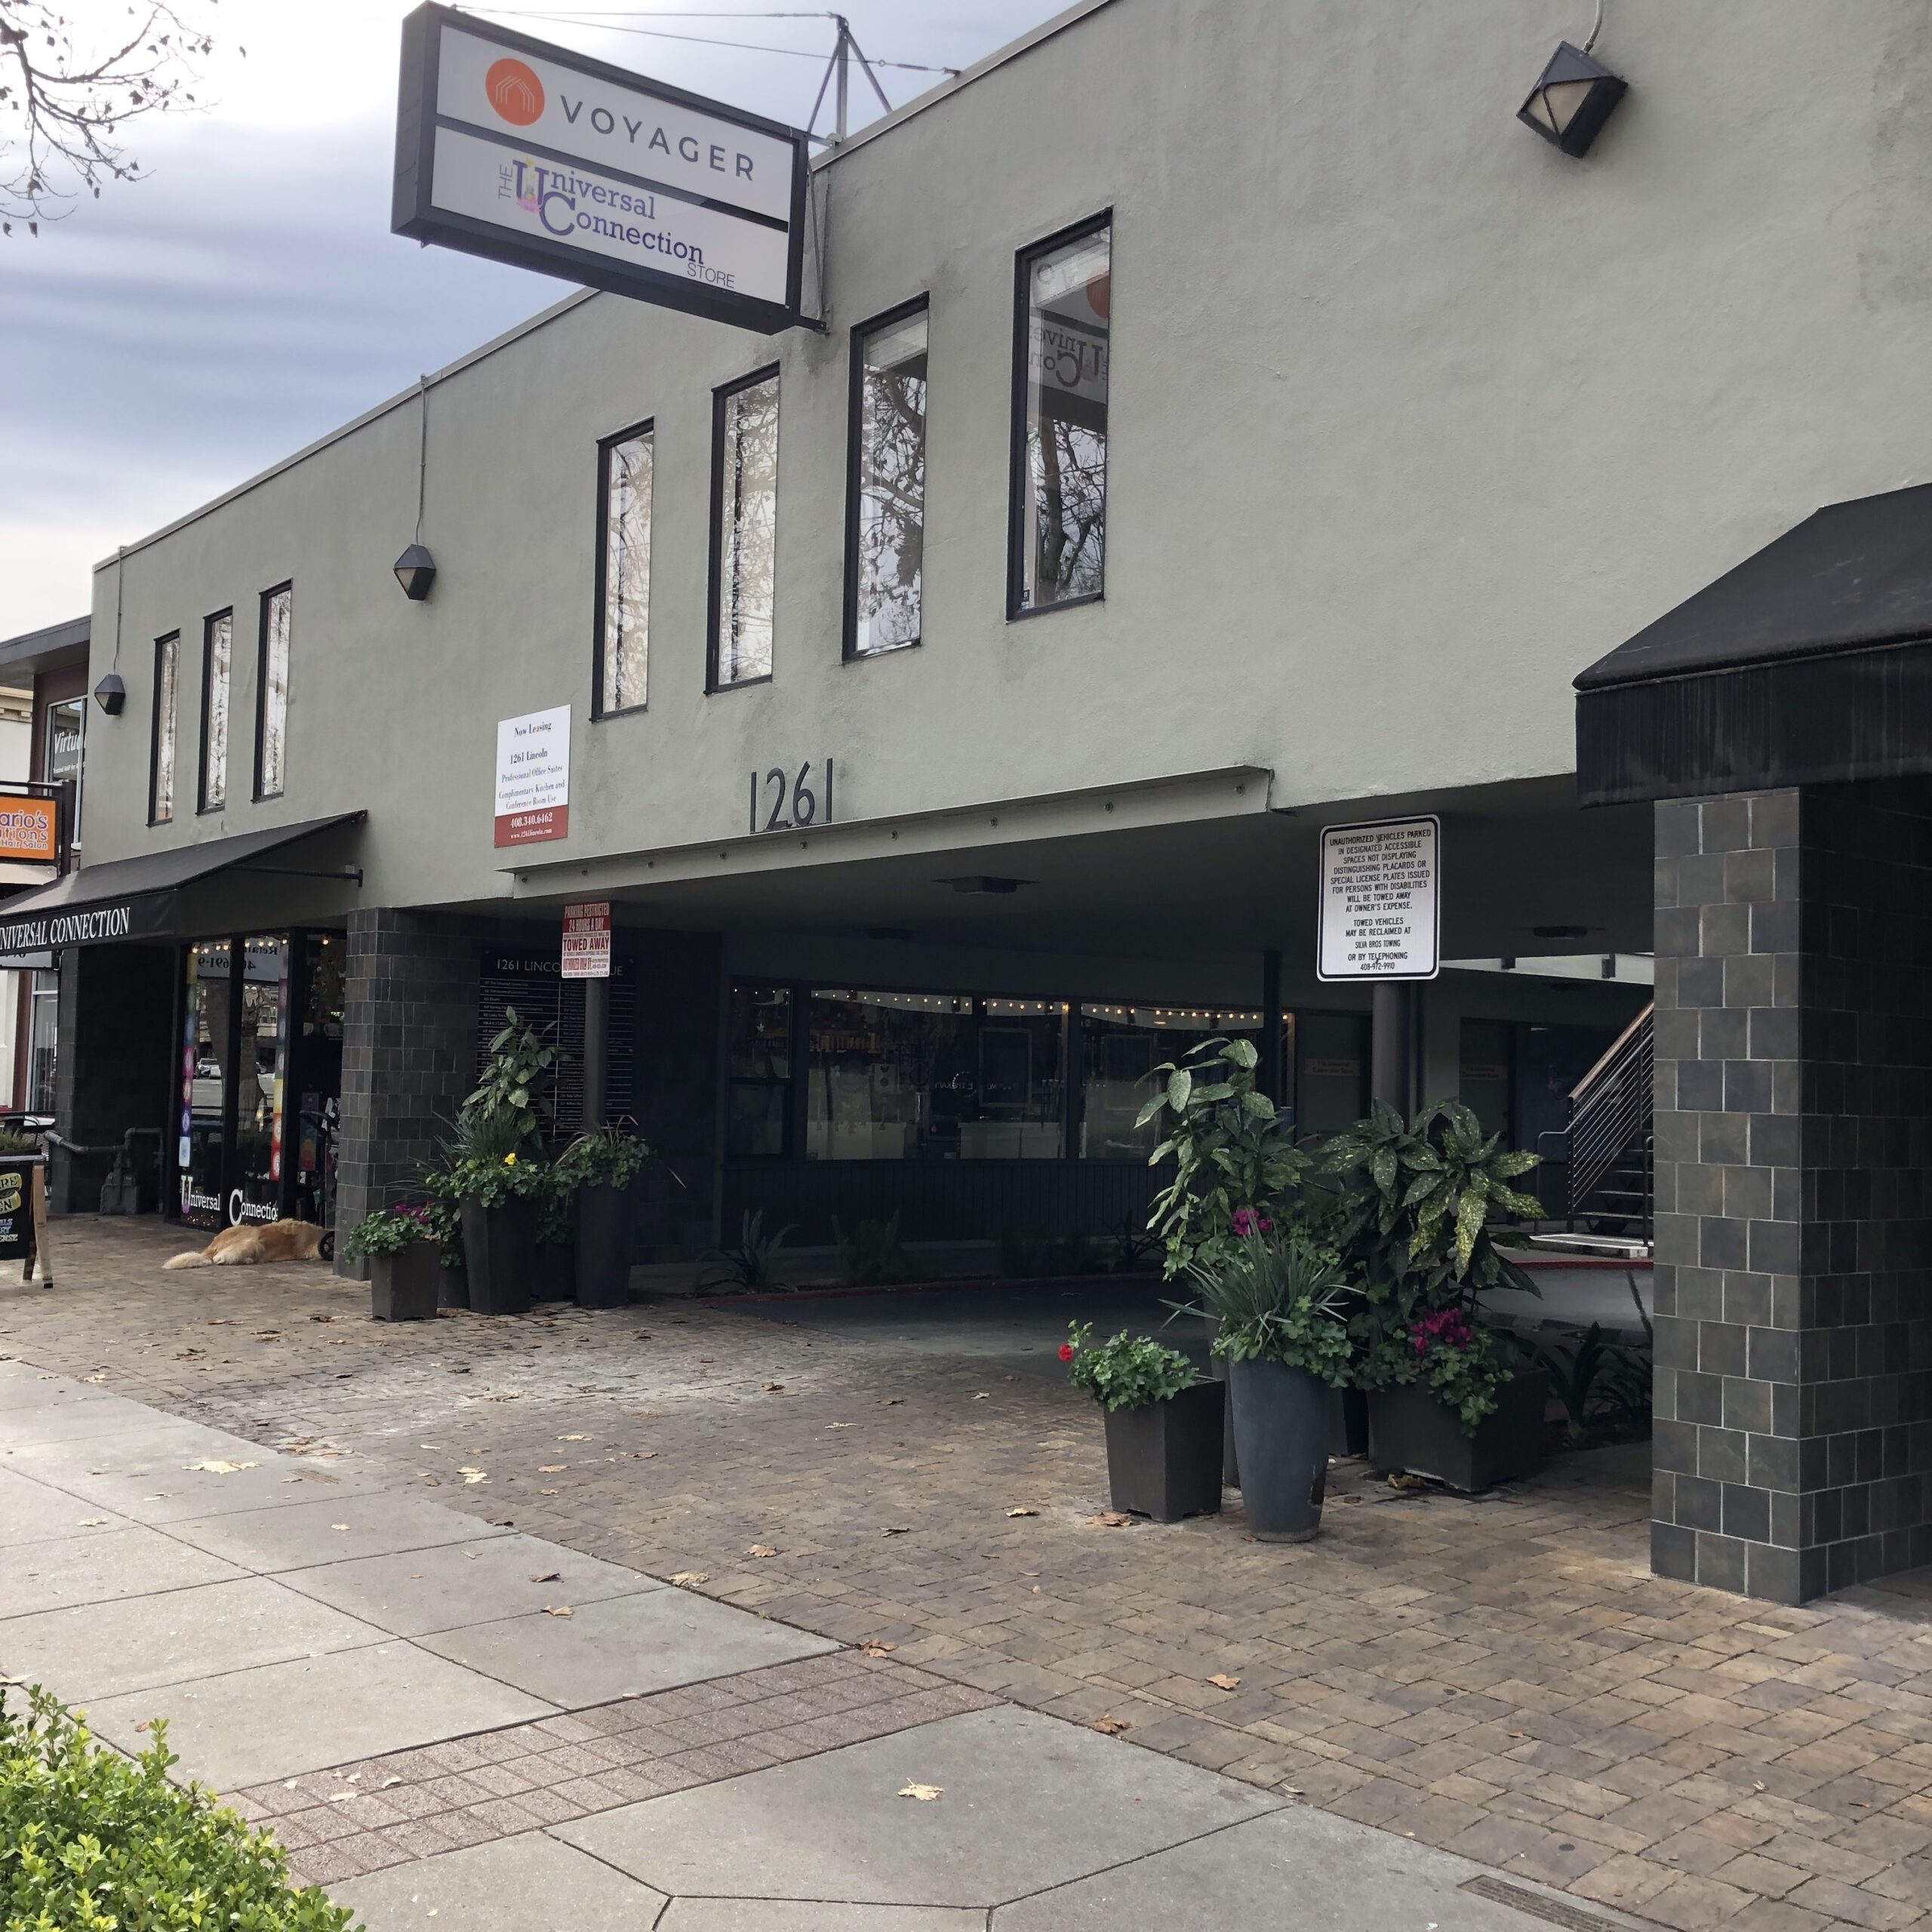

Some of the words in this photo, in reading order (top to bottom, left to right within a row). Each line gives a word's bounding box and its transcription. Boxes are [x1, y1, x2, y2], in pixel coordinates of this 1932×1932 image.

[559, 94, 753, 181] VOYAGER
[498, 164, 513, 199] THE
[512, 159, 655, 220] Universal
[539, 191, 704, 264] Connection
[687, 262, 736, 290] STORE
[514, 727, 527, 737] Now
[528, 722, 552, 735] Leasing
[509, 752, 525, 764] 1261
[526, 748, 548, 761] Lincoln
[501, 768, 531, 783] Professional
[531, 766, 546, 777] Office
[547, 765, 563, 775] Suites
[499, 787, 534, 801] Complimentary
[535, 783, 554, 792] Kitchen
[555, 779, 565, 789] and
[749, 758, 832, 834] 1261
[506, 798, 531, 810] Conference
[533, 796, 546, 805] Room
[547, 795, 557, 803] Use
[2, 838, 20, 847] Hair
[23, 841, 47, 849] Salon
[1330, 835, 1374, 846] UNAUTHORIZED
[1377, 832, 1404, 842] VEHICLES
[1407, 829, 1431, 838] PARKED
[1346, 844, 1382, 854] DESIGNATED
[1384, 840, 1422, 851] ACCESSIBLE
[1343, 856, 1365, 864] SPACES
[1382, 851, 1417, 860] DISPLAYING
[1334, 864, 1380, 875] DISTINGUISHING
[1383, 861, 1415, 871] PLACARDS
[1331, 876, 1354, 884] SPECIAL
[1356, 874, 1380, 883] LICENSE
[1383, 872, 1405, 881] PLATES
[1407, 870, 1430, 878] ISSUED
[1346, 884, 1372, 894] PERSONS
[1374, 883, 1388, 891] WITH
[1390, 880, 1427, 890] DISABILITIES
[1355, 903, 1380, 912] OWNER'S
[1383, 901, 1413, 910] EXPENSE.
[50, 907, 130, 944] CONNECTION
[569, 918, 575, 932] 24
[576, 918, 590, 931] HOURS
[591, 918, 594, 931] A
[595, 917, 604, 930] DAY
[1375, 917, 1404, 926] VEHICLES
[1369, 927, 1401, 936] RECLAIMED
[564, 938, 587, 951] TOWED
[589, 937, 609, 950] AWAY
[1358, 952, 1366, 961] BY
[1368, 952, 1407, 961] TELEPHONING
[497, 958, 519, 971] 1261
[525, 960, 561, 973] LINCO
[0, 1176, 18, 1188] RE
[181, 1175, 220, 1214] Universal
[229, 1189, 278, 1226] Connectio
